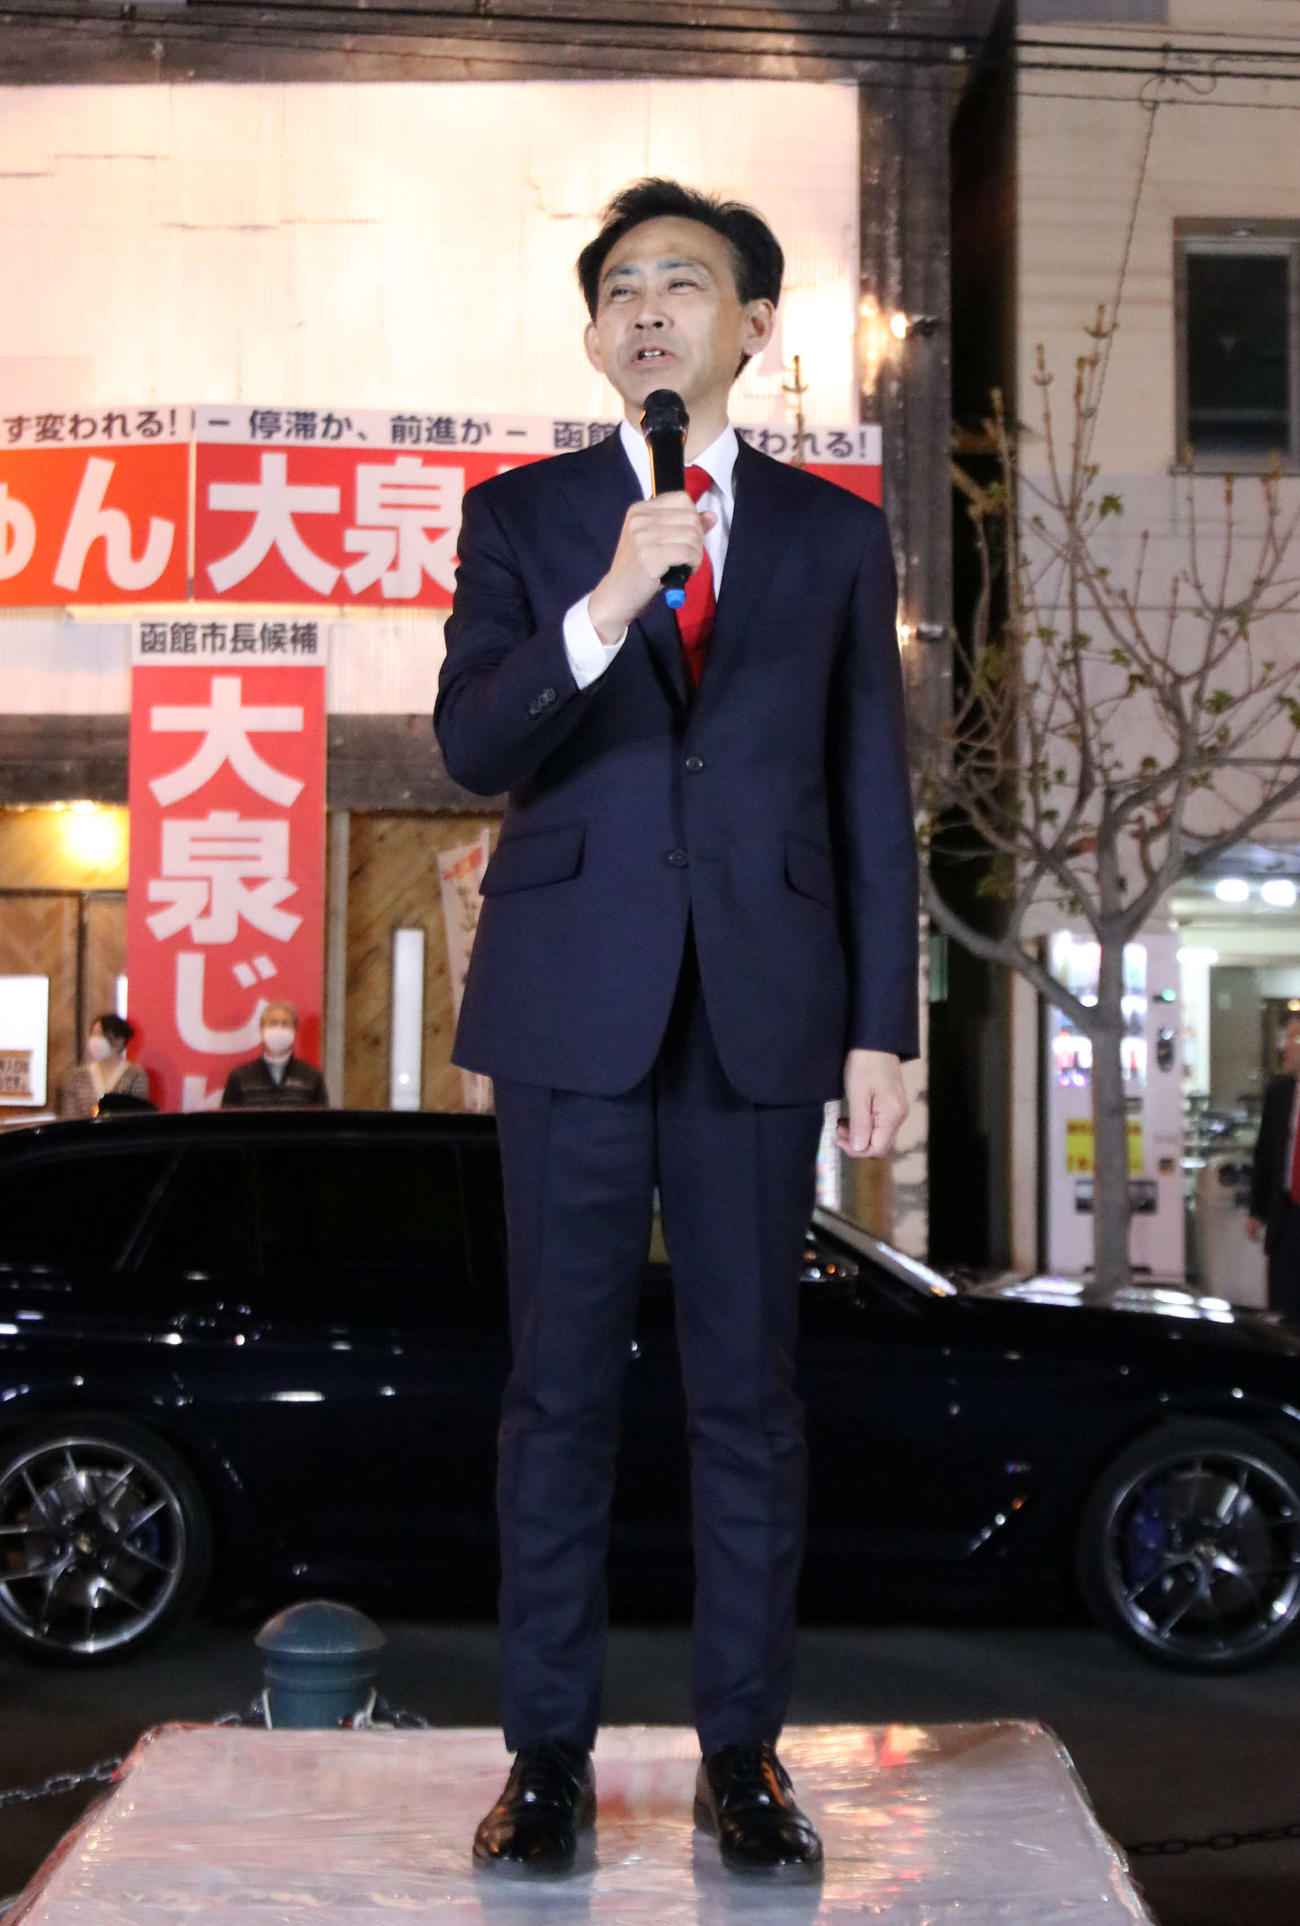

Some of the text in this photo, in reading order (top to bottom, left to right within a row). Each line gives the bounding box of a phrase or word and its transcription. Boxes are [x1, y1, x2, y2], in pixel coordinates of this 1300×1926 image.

[249, 410, 492, 445] 停滞か、前進か
[206, 452, 517, 600] 大泉
[140, 622, 318, 653] 函館市長候補
